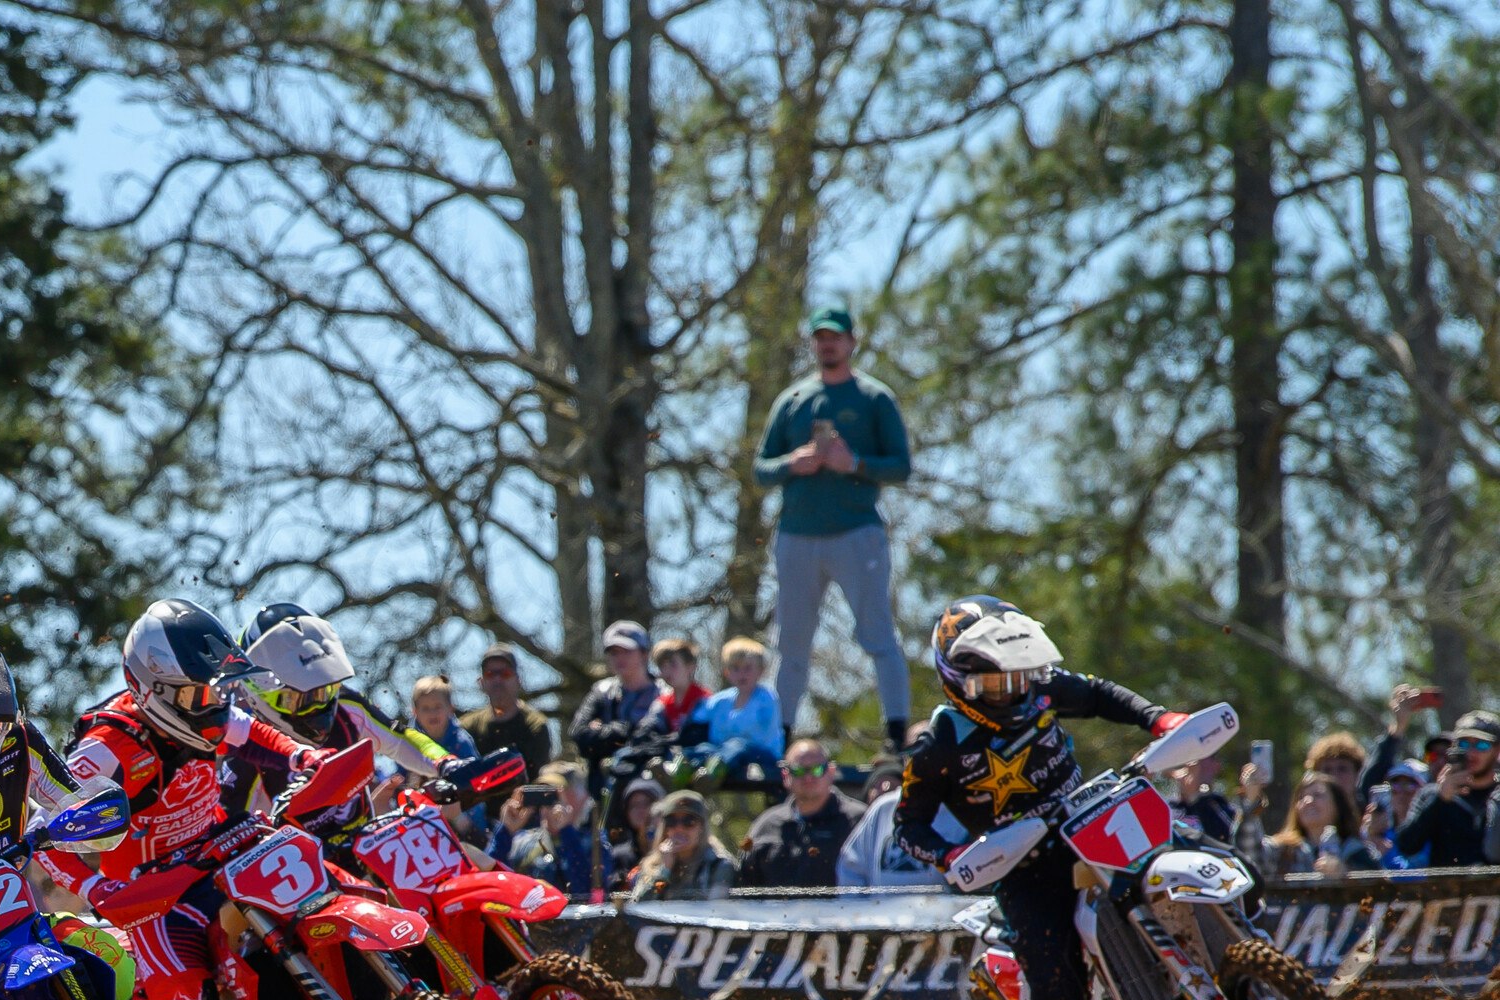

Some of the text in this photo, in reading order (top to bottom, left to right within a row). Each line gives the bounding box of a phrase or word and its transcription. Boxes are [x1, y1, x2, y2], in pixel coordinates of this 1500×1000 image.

[378, 817, 462, 891] 282
[1104, 800, 1153, 862] 1
[260, 843, 315, 905] 3
[23, 955, 61, 977] YAMAHA
